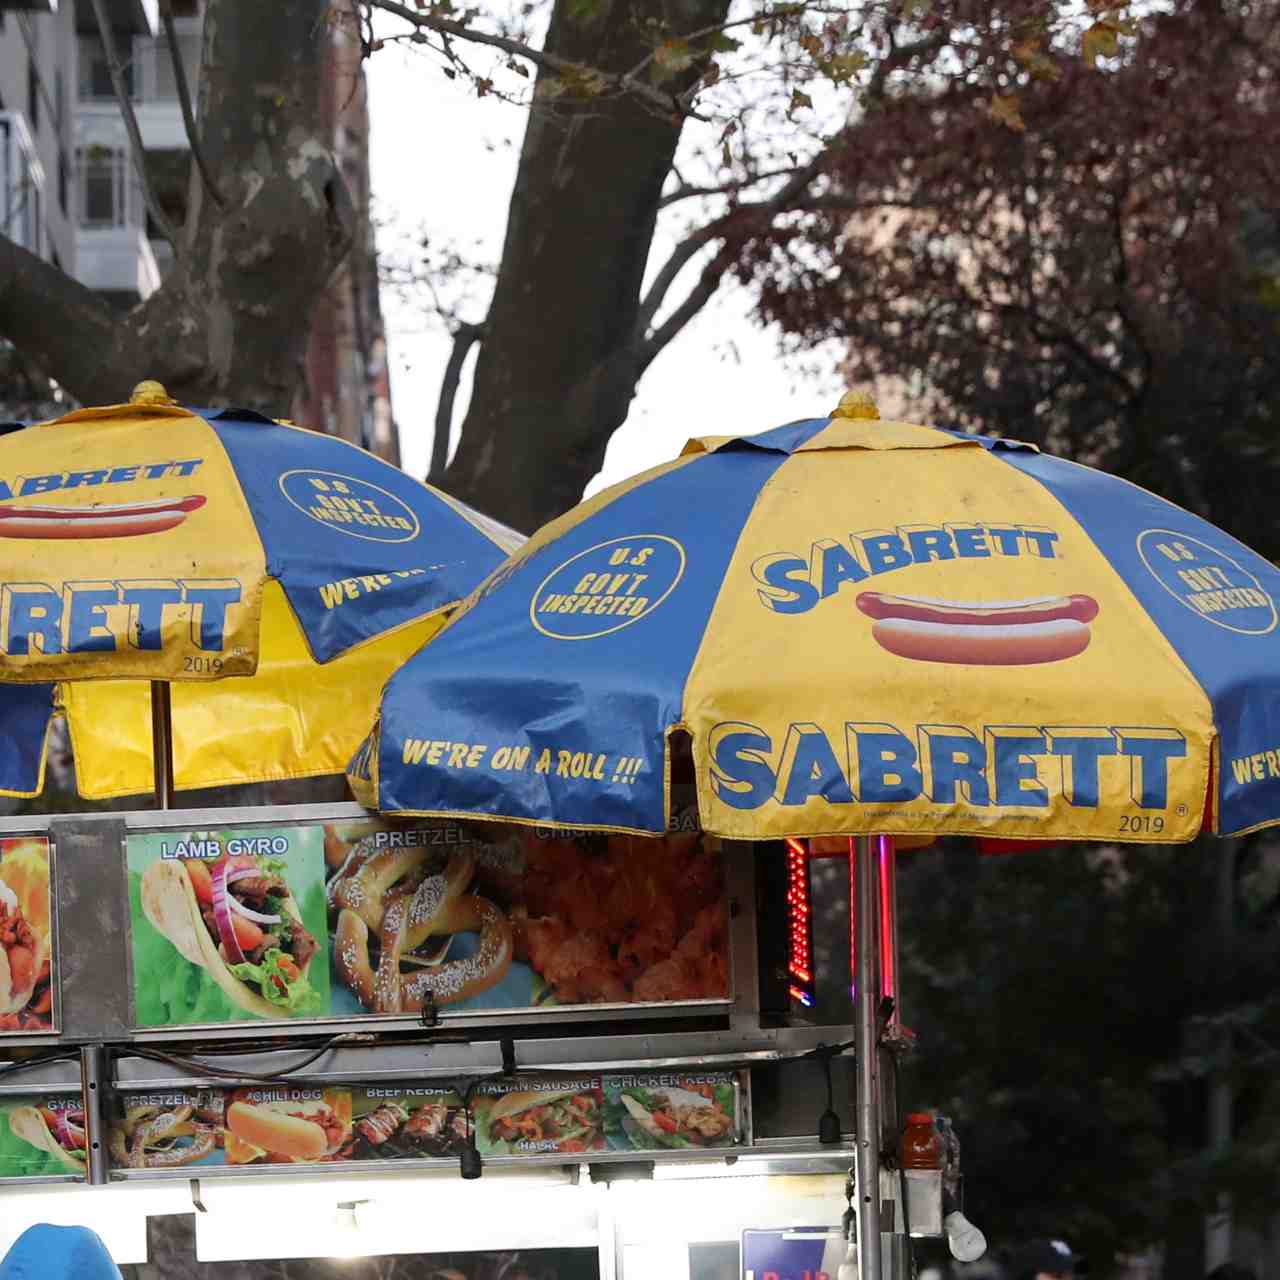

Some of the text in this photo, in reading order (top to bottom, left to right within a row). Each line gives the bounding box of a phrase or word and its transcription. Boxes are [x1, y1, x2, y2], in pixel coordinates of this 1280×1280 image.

[608, 548, 654, 566] U.S.
[751, 522, 1059, 614] SABRETT
[575, 573, 647, 594] GOV'T
[538, 593, 648, 617] INSPECTED
[184, 656, 224, 673] 2019
[403, 739, 487, 769] WE'RE
[492, 746, 529, 770] ON
[536, 748, 553, 772] A
[557, 752, 605, 780] ROLL
[709, 722, 1186, 810] SABRETT
[1120, 815, 1164, 834] 2019
[162, 835, 290, 860] LAMB GYRO
[375, 827, 470, 848] PRETZEL
[476, 1078, 601, 1094] ITALIAN SAUSAGE
[610, 1076, 680, 1089] CHICKEN
[127, 1094, 190, 1107] PRETZEL
[249, 1089, 321, 1101] CHILI DOG
